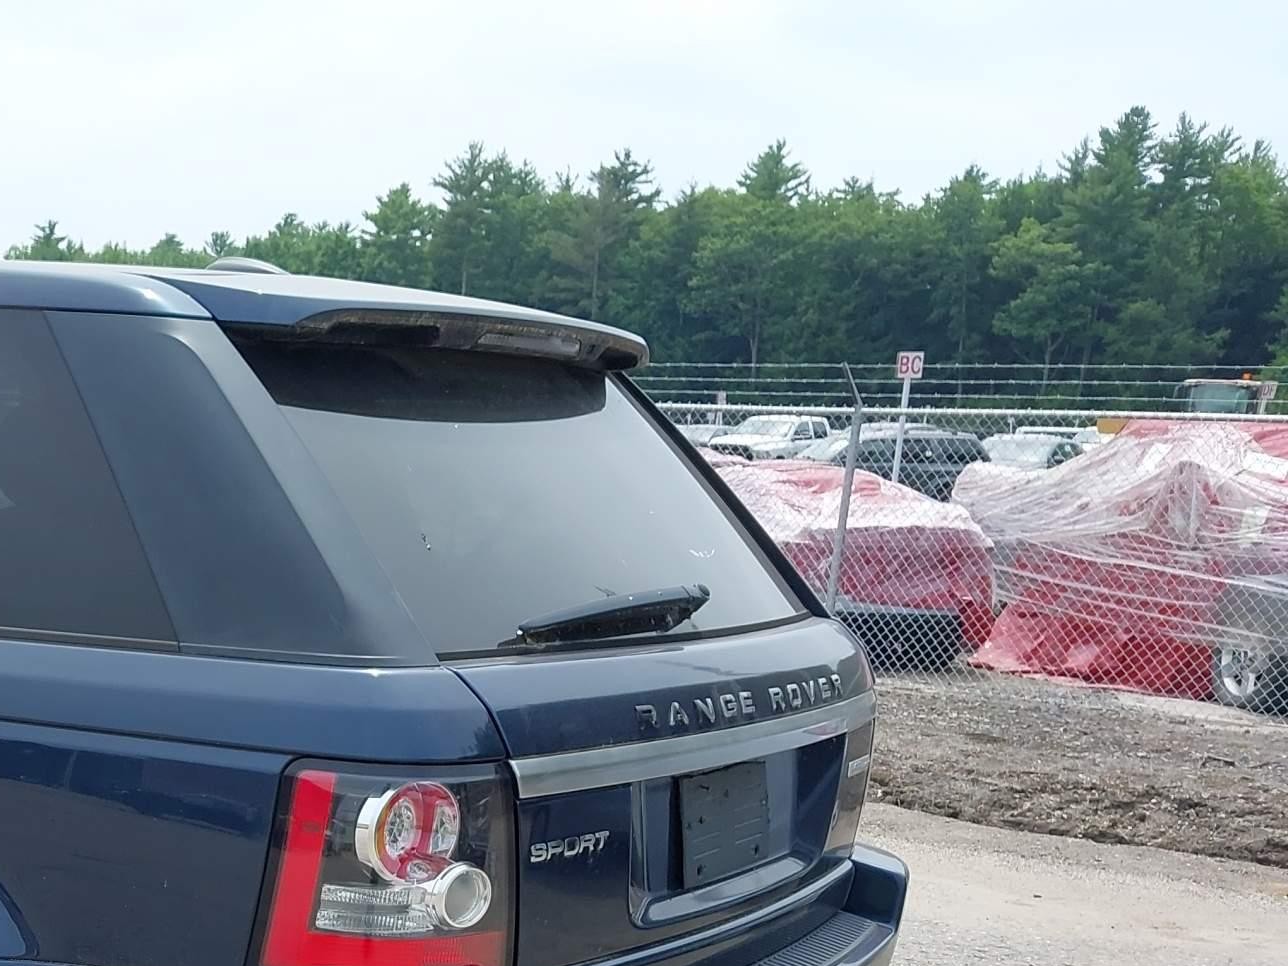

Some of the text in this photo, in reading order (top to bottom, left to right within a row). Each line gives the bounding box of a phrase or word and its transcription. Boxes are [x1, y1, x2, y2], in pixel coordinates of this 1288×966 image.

[899, 355, 922, 374] BC
[634, 673, 844, 730] RANGE ROVER
[529, 830, 610, 864] SPORT
